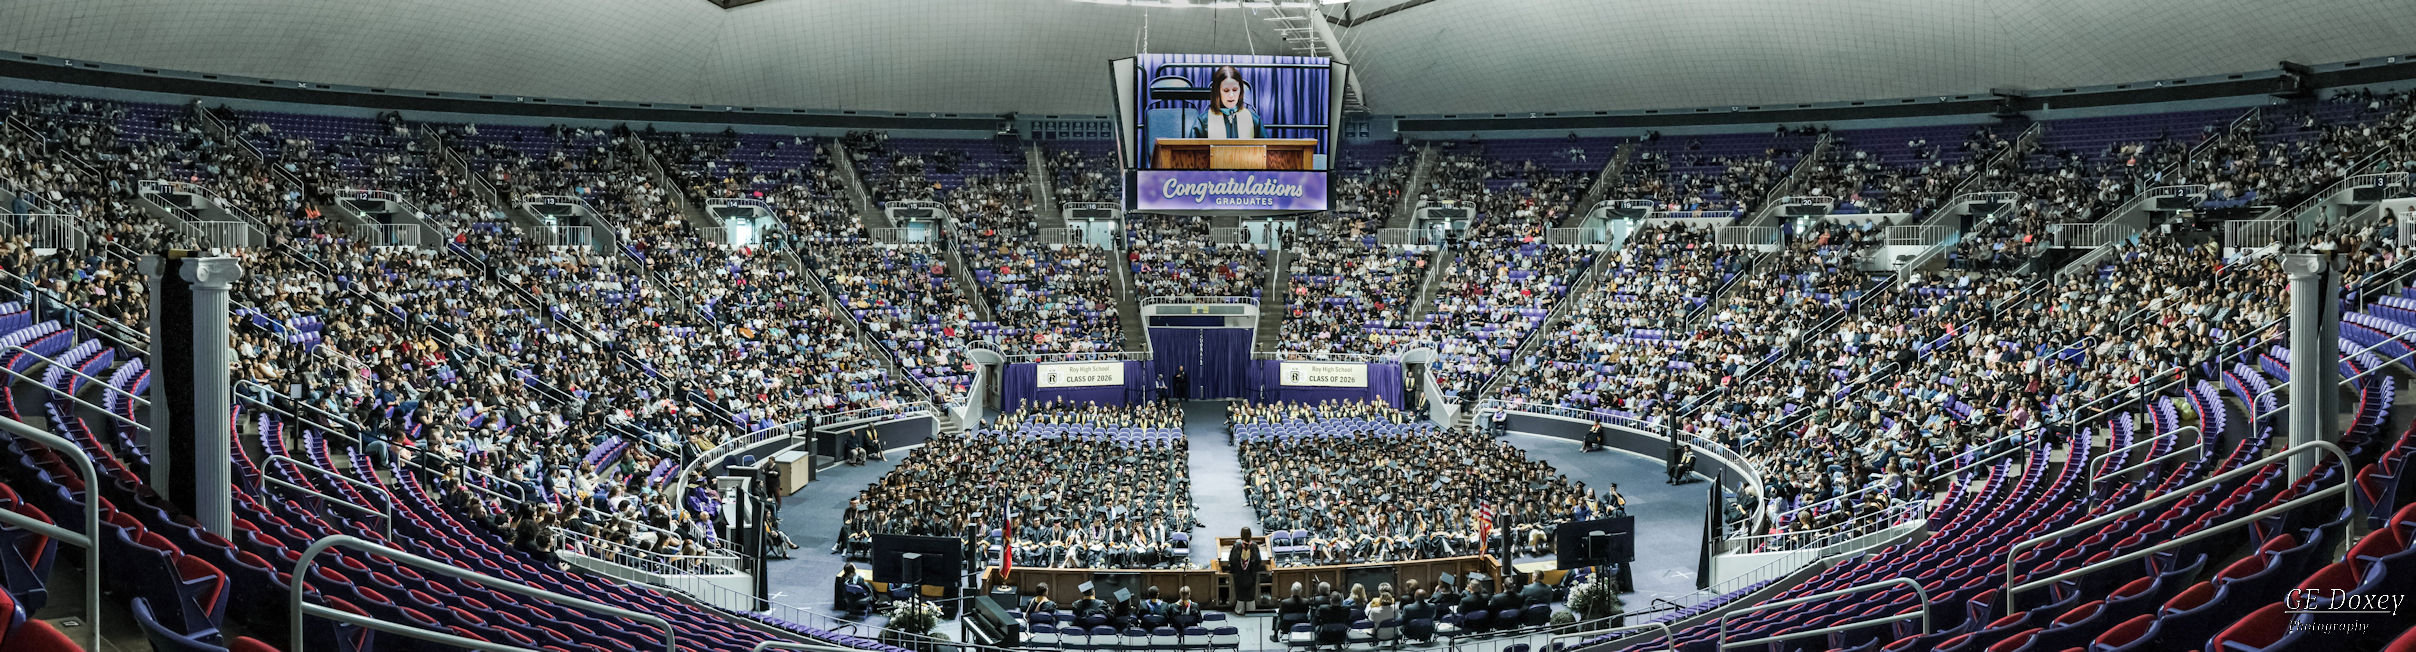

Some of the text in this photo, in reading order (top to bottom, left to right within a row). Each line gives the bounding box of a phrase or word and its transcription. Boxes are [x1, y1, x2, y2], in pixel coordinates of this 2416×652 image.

[2377, 178, 2384, 186] 3
[1162, 175, 1303, 204] Congratulations
[1215, 197, 1273, 206] GRADUATES
[1097, 374, 1112, 382] 2026
